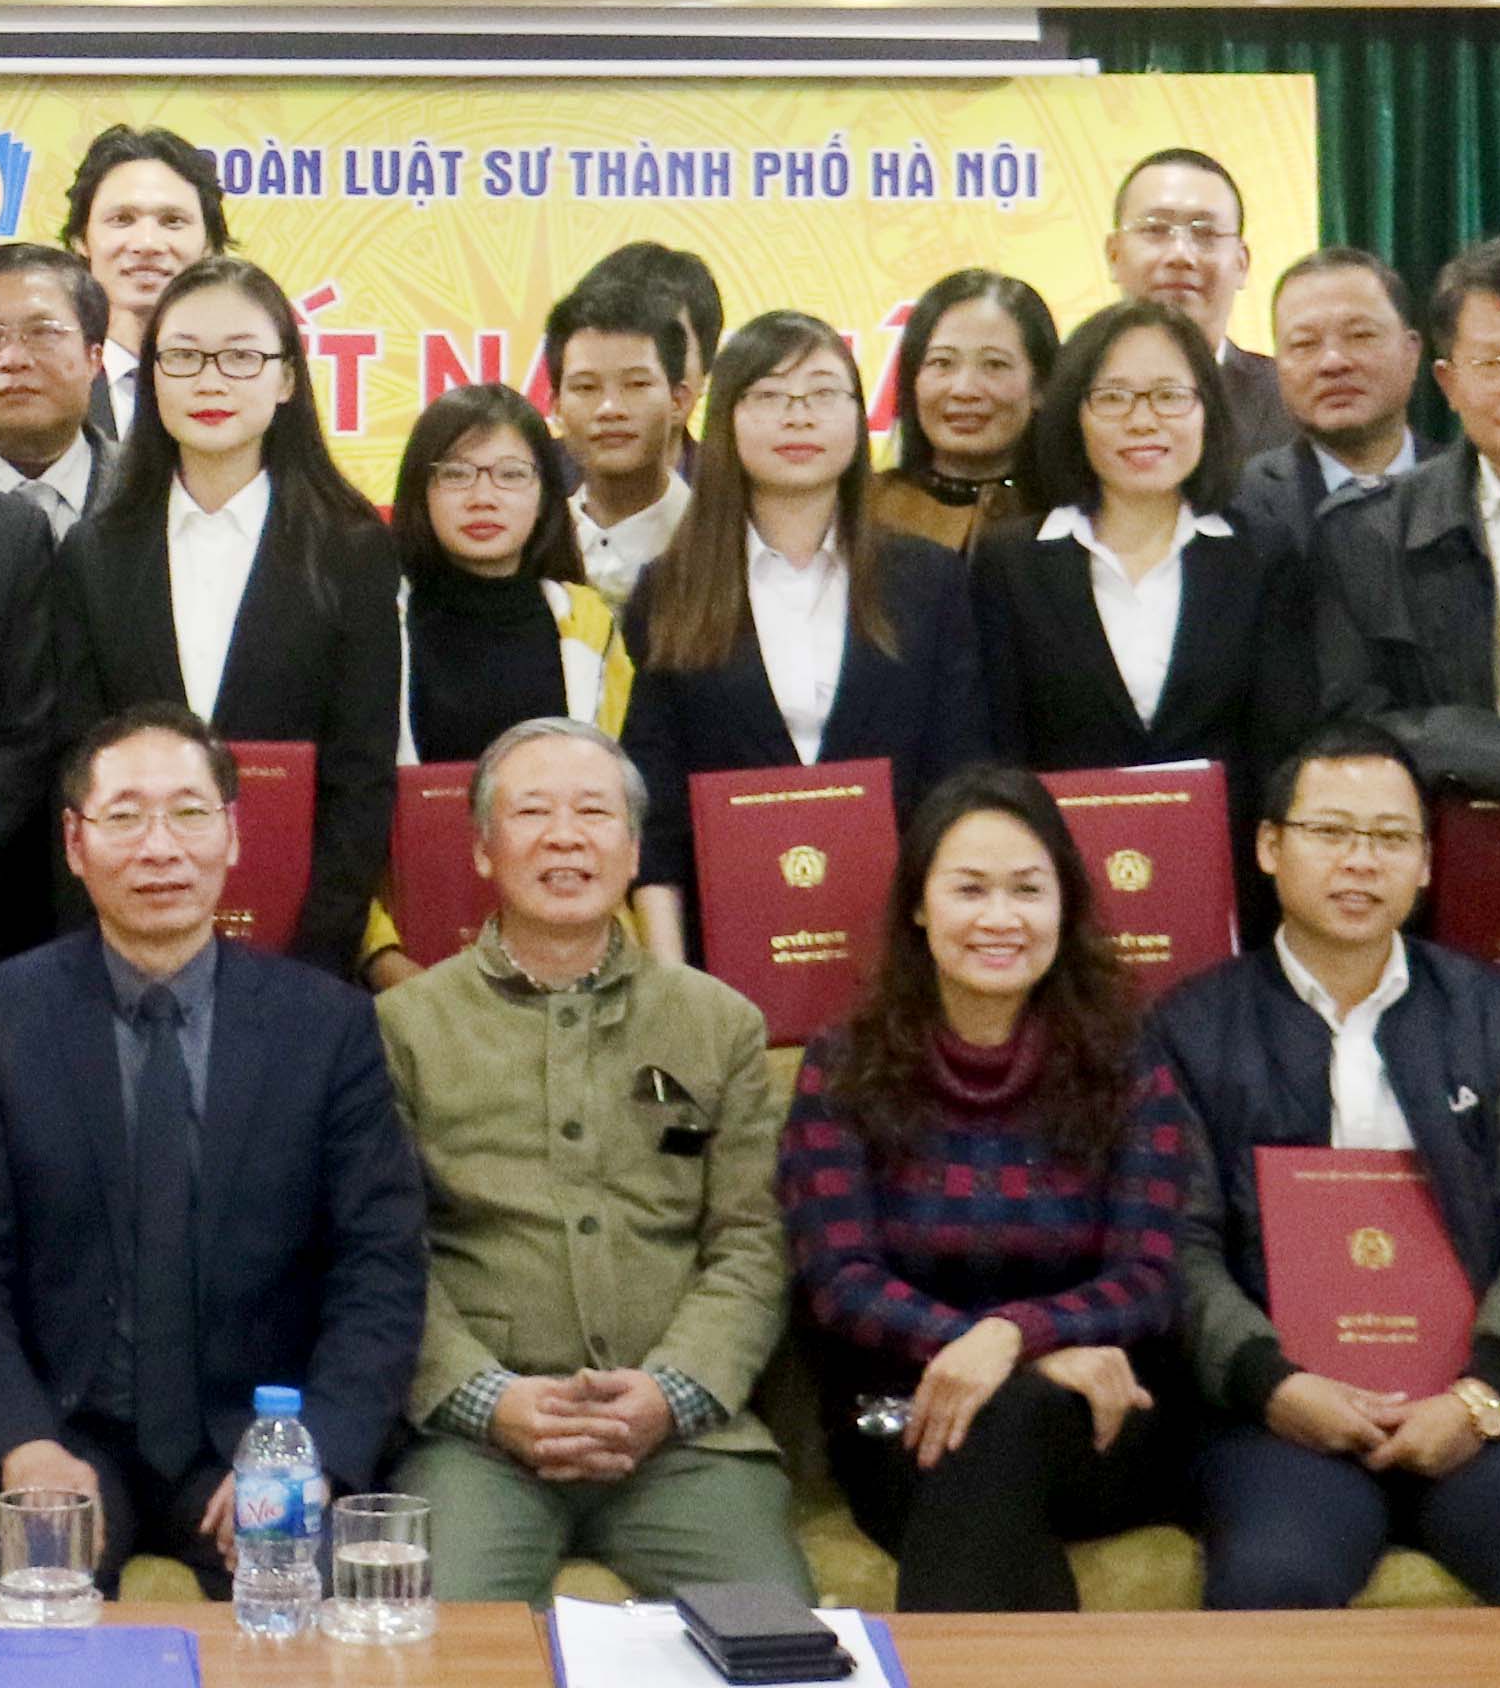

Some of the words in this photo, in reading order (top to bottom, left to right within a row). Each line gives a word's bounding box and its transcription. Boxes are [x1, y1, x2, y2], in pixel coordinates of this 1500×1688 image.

[198, 138, 322, 196] OÀN
[345, 140, 464, 207] LUẬT
[484, 146, 552, 197] SƯ
[569, 141, 731, 197] THÀNH
[754, 132, 849, 197] PHỐ
[873, 141, 935, 197] HÀ
[957, 142, 1037, 208] NỘI
